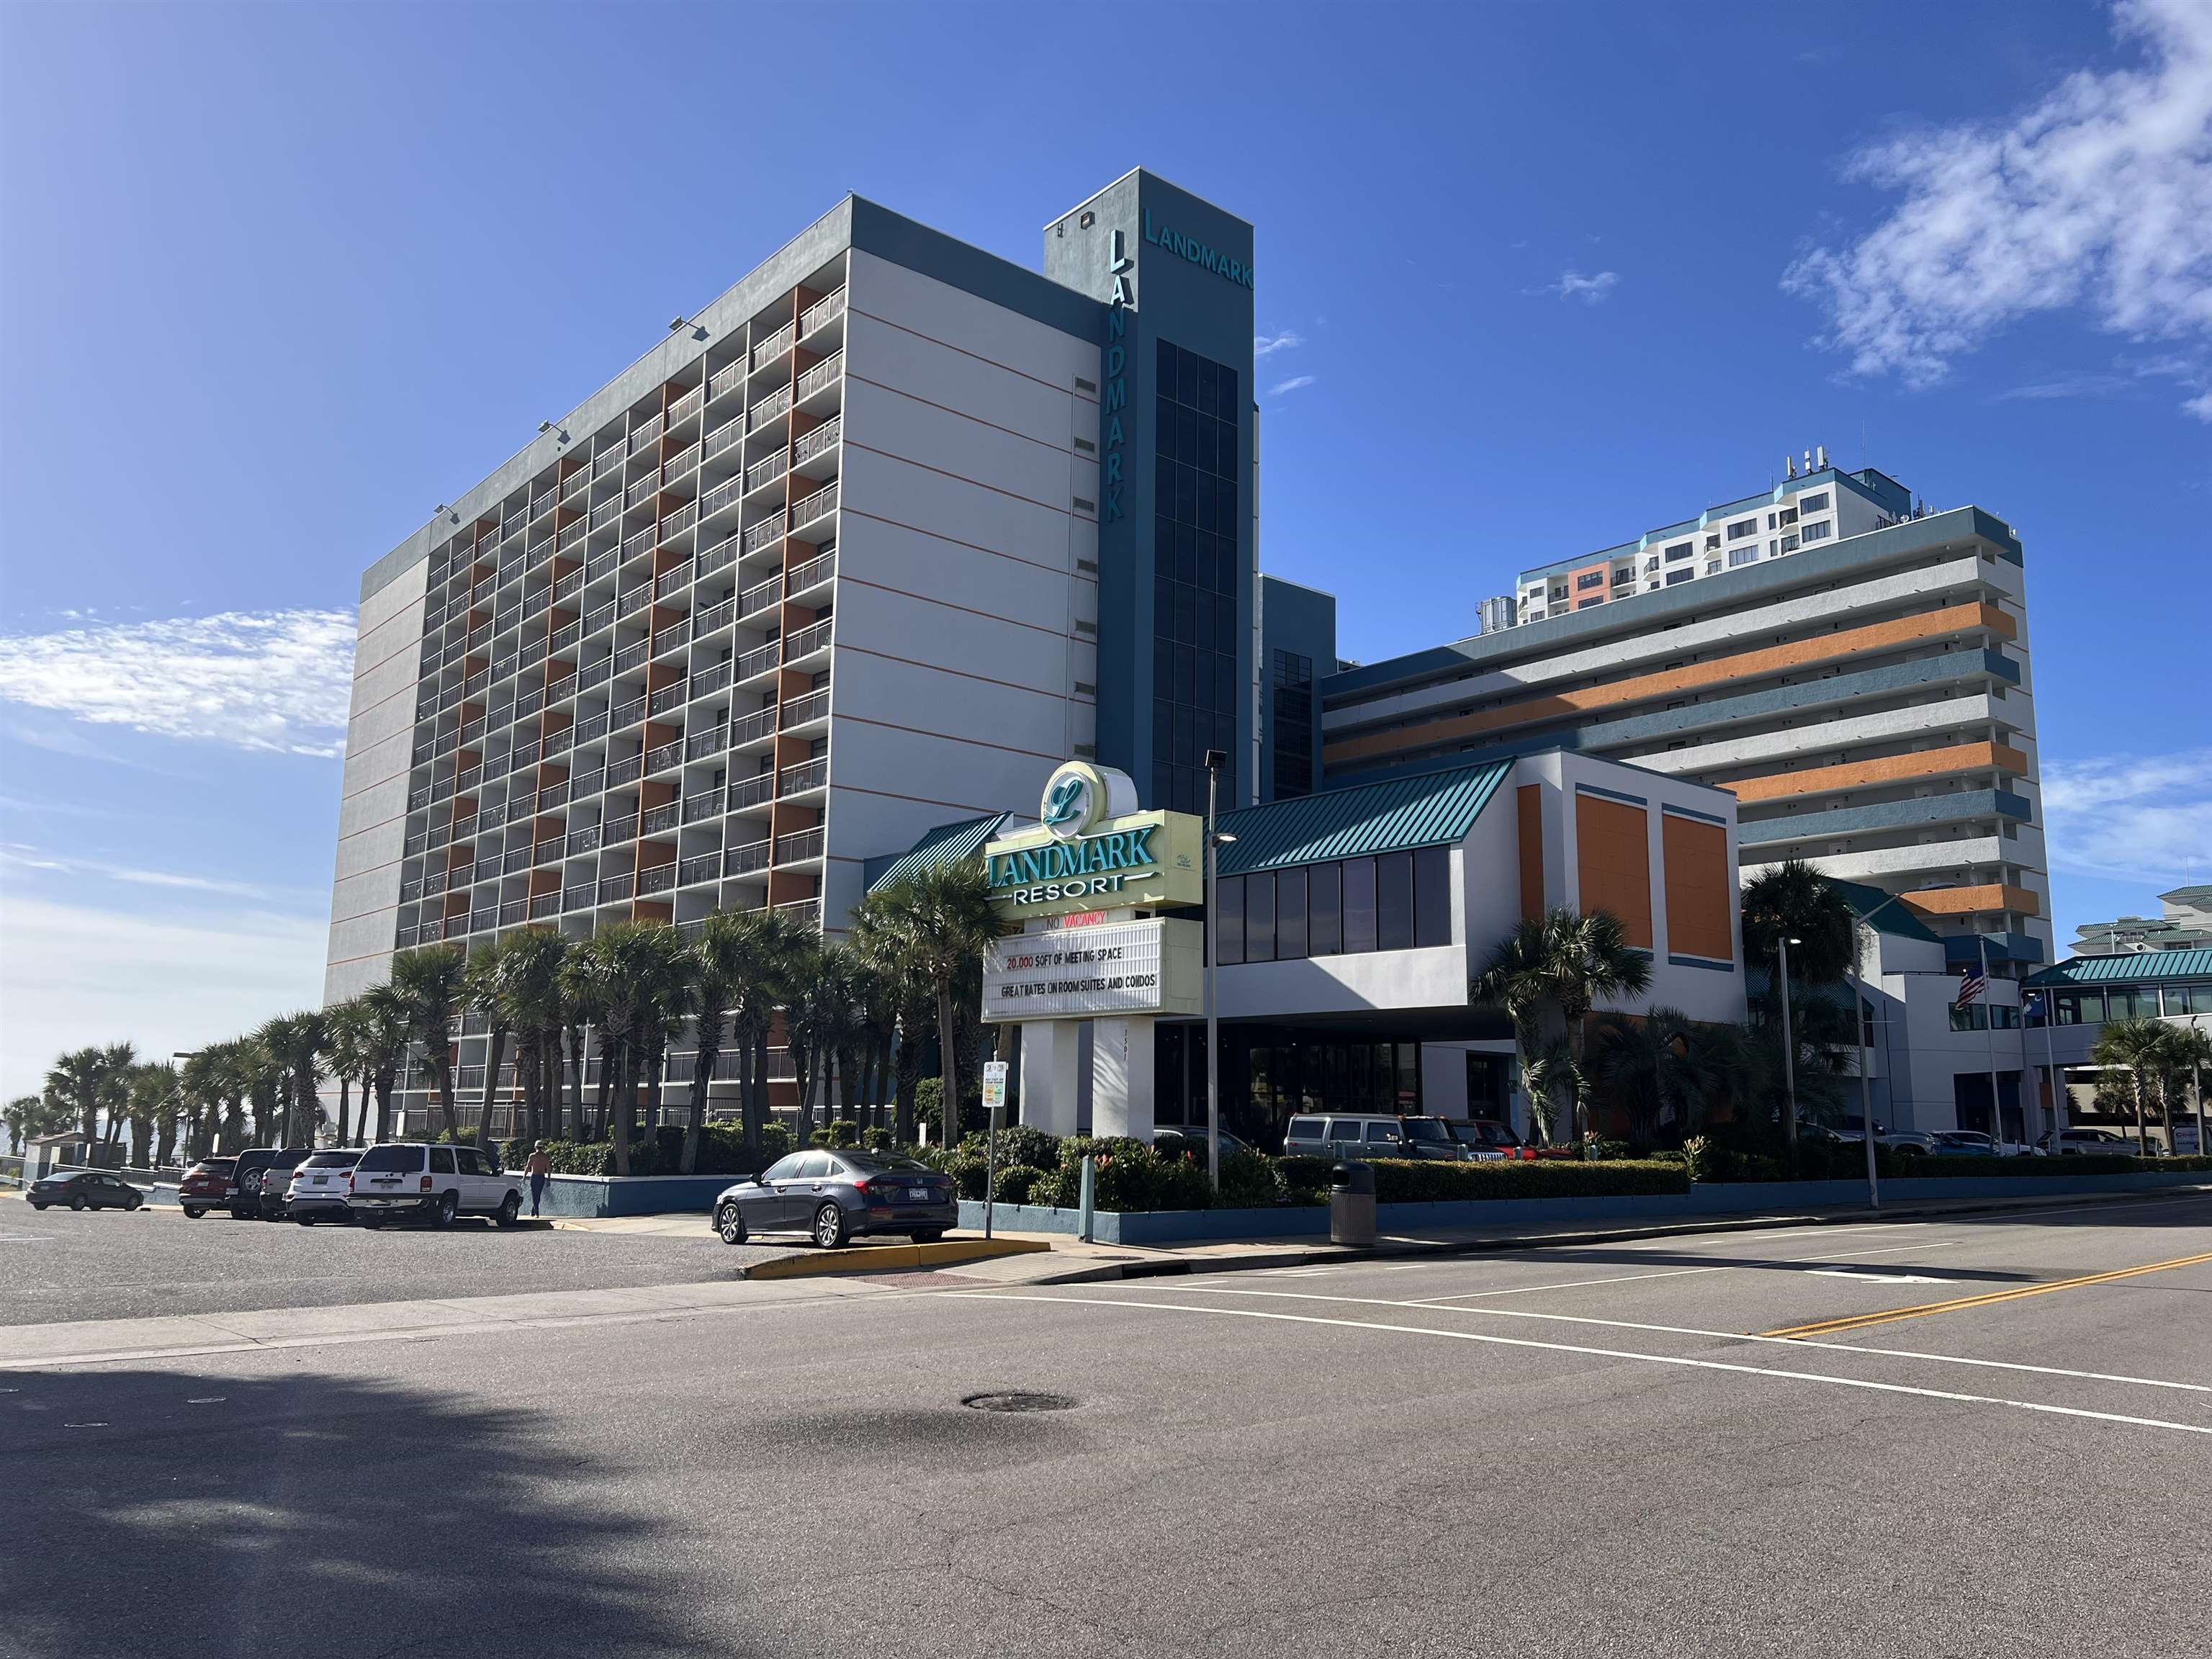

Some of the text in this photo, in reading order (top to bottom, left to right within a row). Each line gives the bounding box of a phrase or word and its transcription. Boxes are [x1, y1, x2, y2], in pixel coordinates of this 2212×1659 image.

[1143, 207, 1254, 291] LANDMARK
[1106, 229, 1131, 522] LANDMARK
[987, 830, 1155, 887] LANDMARK
[1013, 874, 1125, 906] RESORT
[1063, 910, 1107, 928] VACANCY
[1053, 953, 1062, 965] OF
[1064, 949, 1094, 964] MEETING
[1097, 947, 1122, 961] SPACE
[1002, 985, 1025, 997] GREAT
[1025, 983, 1046, 996] RATES
[1048, 982, 1058, 994] ON
[1080, 978, 1106, 992] SUITES
[1107, 976, 1123, 990] AND
[1125, 974, 1156, 989] CONDOS
